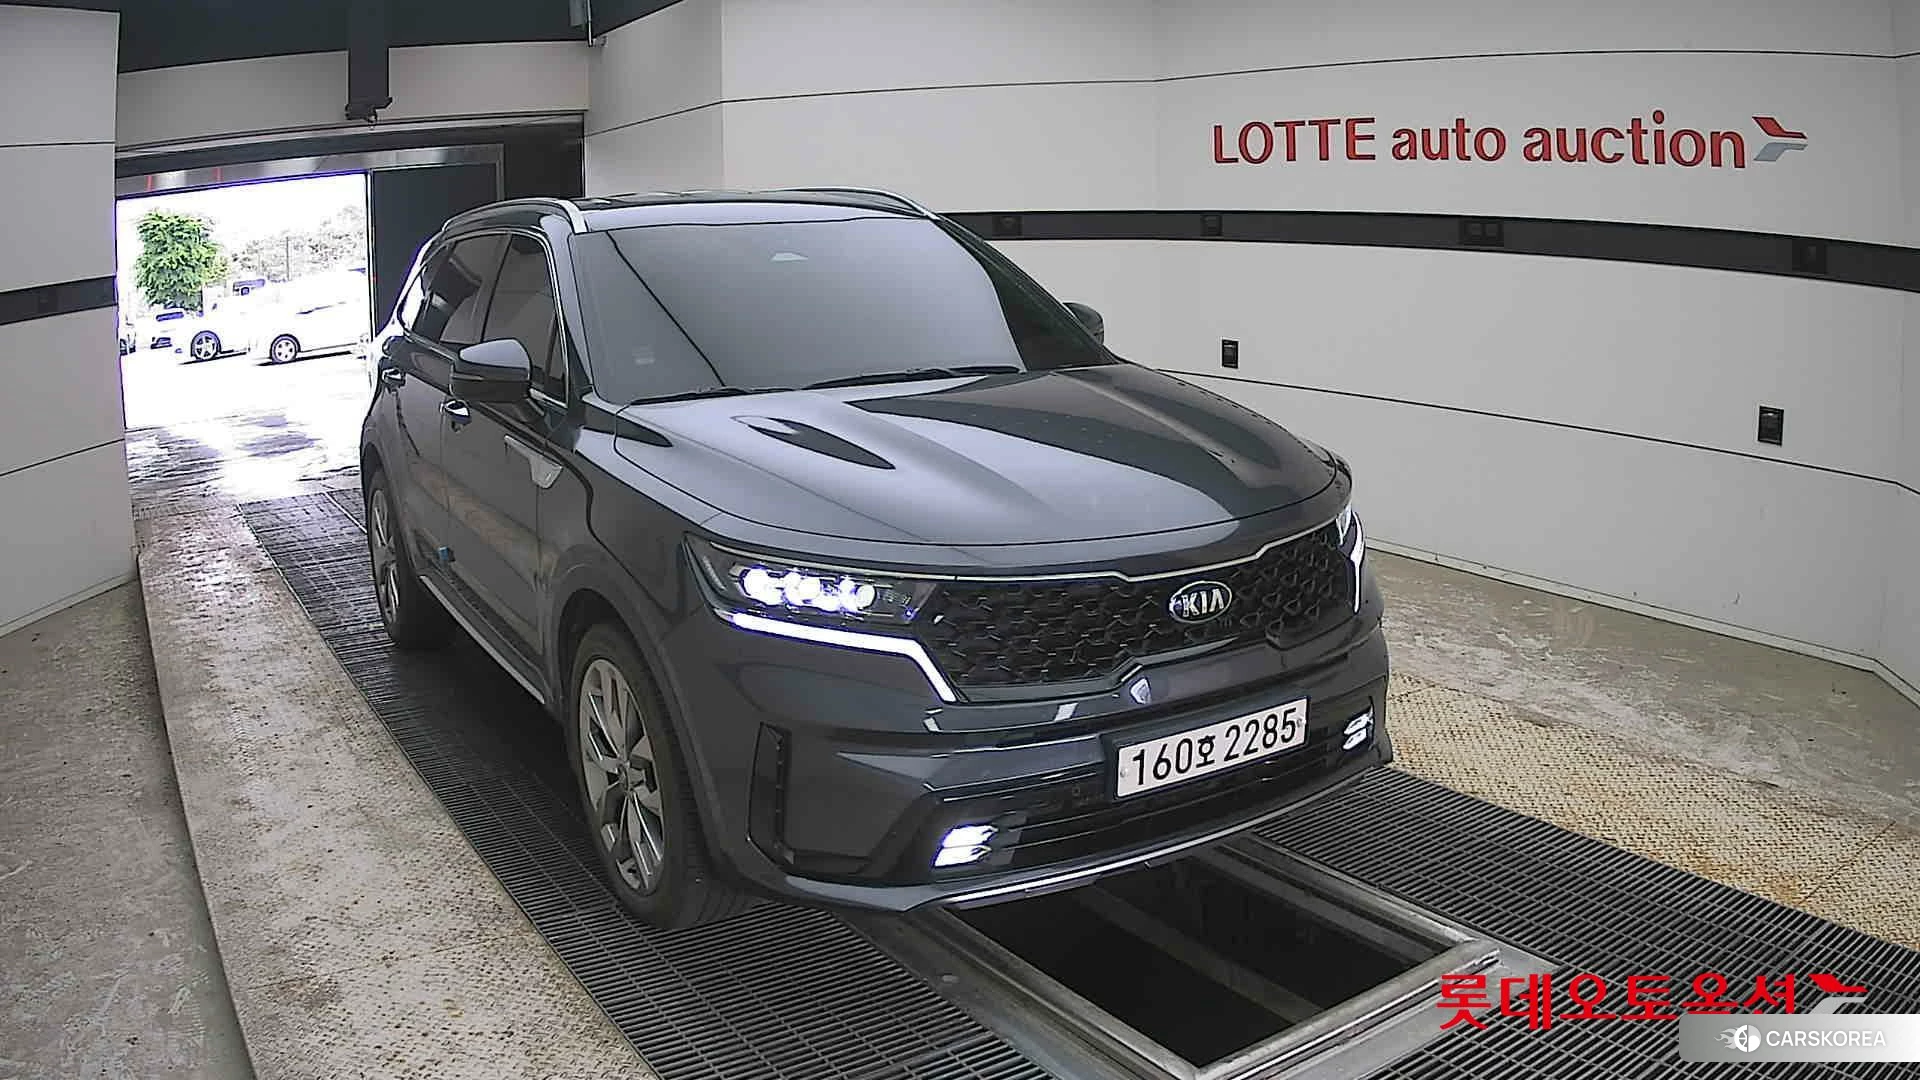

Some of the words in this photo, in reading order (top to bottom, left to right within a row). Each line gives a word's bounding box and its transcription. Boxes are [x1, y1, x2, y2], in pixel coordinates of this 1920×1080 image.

[1213, 117, 1376, 165] LOTTE
[1391, 117, 1507, 162] auto
[1523, 109, 1746, 169] auction
[1182, 588, 1225, 618] KIA
[1132, 735, 1216, 786] 160호
[1223, 707, 1299, 762] 2285
